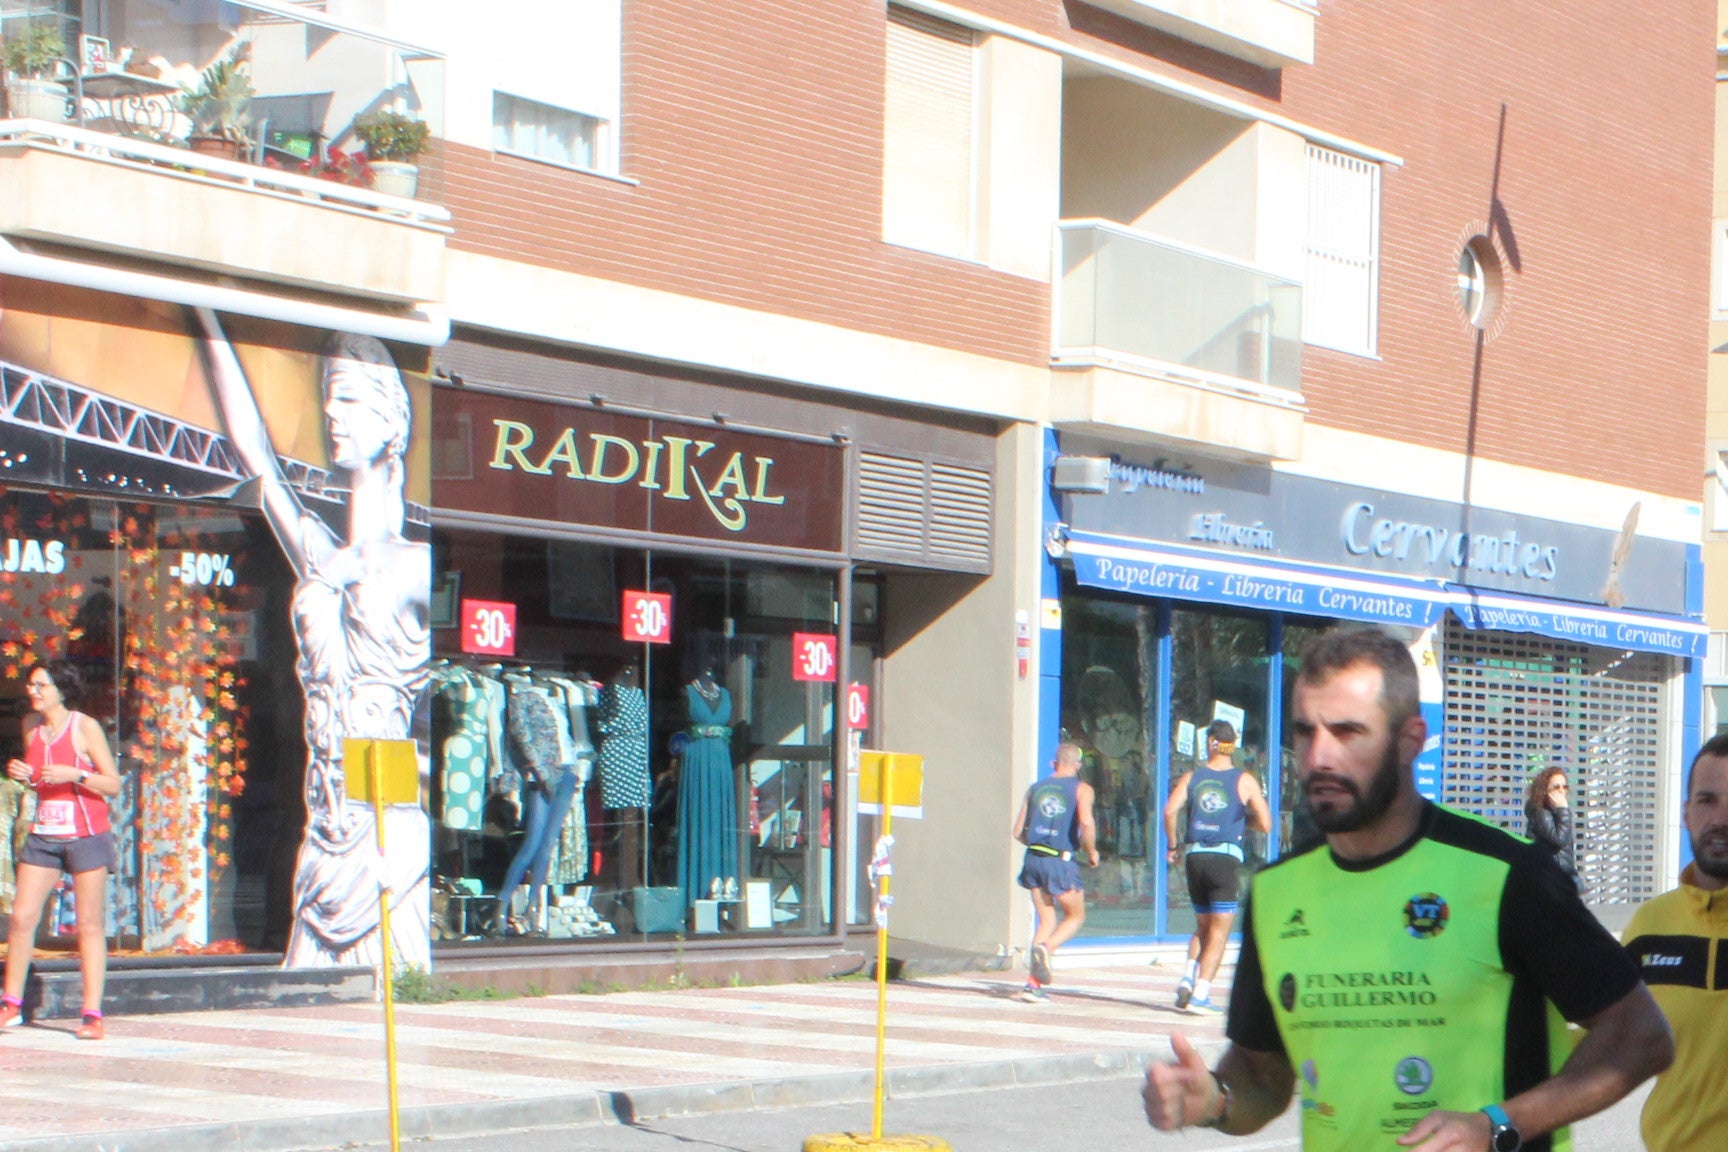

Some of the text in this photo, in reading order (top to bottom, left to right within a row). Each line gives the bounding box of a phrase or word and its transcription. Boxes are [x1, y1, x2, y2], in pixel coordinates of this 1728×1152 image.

[489, 418, 785, 532] RADIKAL
[0, 539, 65, 574] JAS
[1341, 502, 1559, 581] Cervantes
[170, 553, 235, 588] -50%
[1096, 557, 1200, 593] Papeleria
[1221, 574, 1305, 605] Libreria
[1319, 586, 1413, 619] Cervantes
[1552, 616, 1608, 639] Libreria
[1616, 623, 1683, 649] Cervantes
[1304, 970, 1432, 989] FUNERARIA
[1301, 990, 1437, 1009] GUILLERMO
